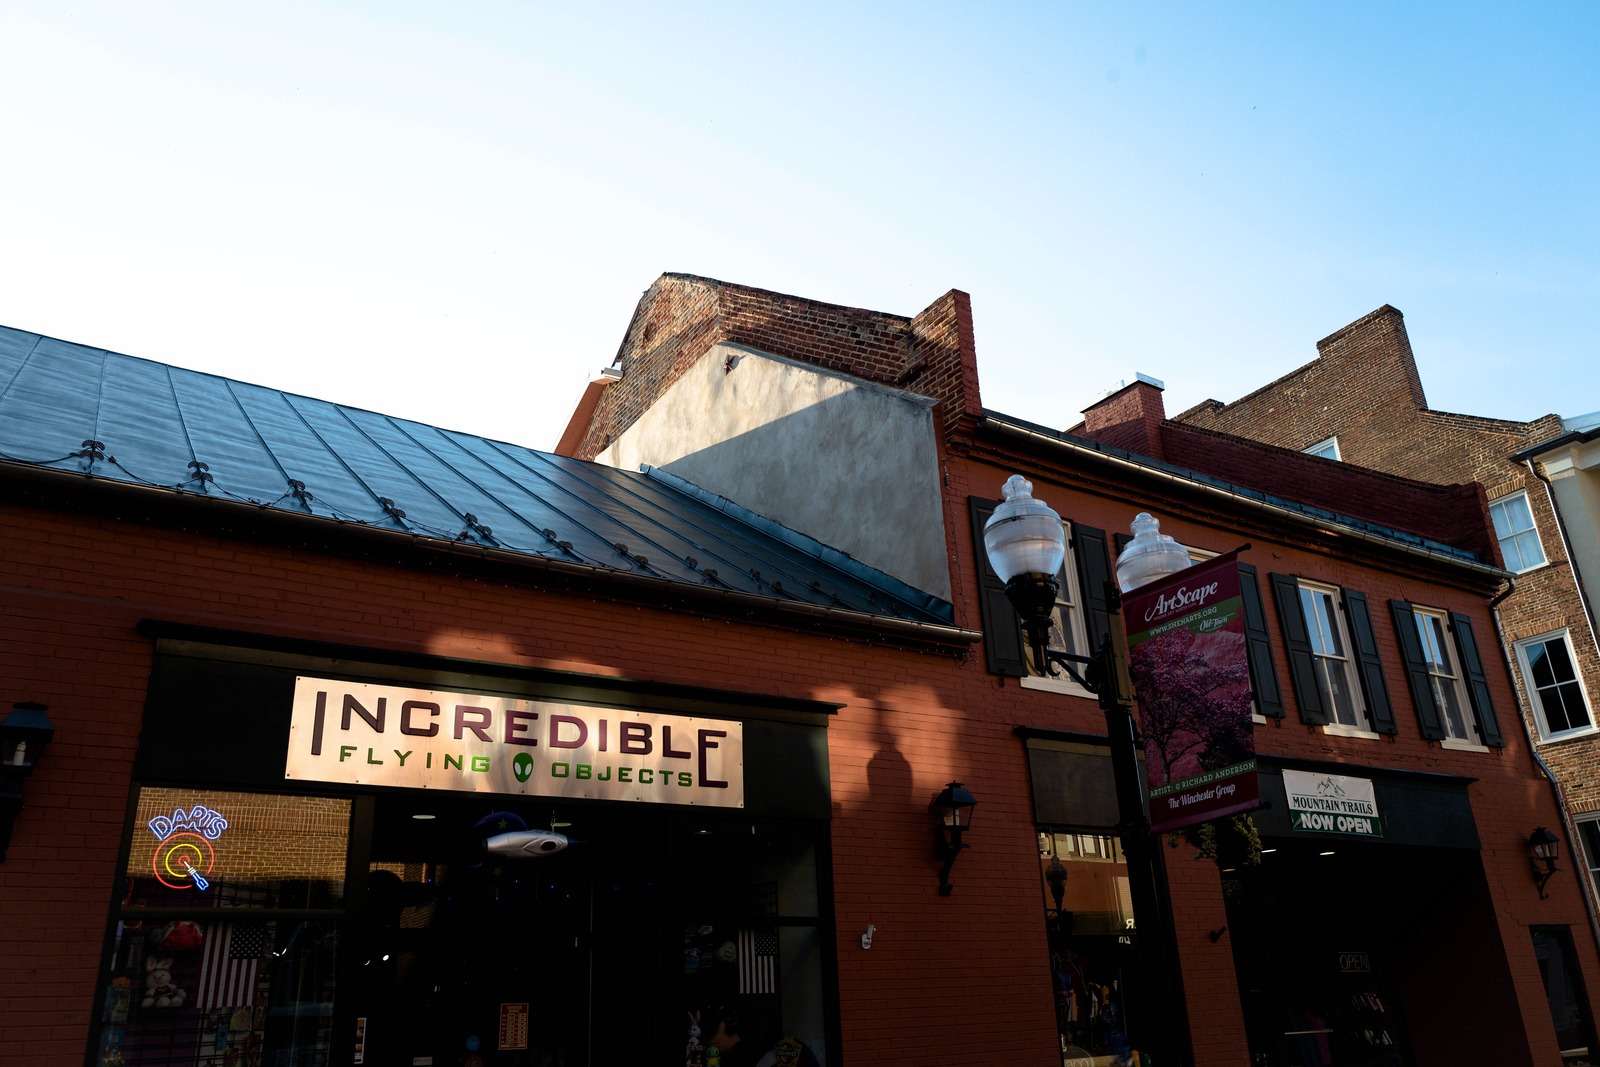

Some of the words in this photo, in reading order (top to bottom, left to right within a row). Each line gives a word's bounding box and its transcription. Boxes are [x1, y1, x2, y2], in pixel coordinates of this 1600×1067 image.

[1145, 582, 1218, 622] ArtScape
[1149, 606, 1218, 637] WWW.SHENARTS.ORG
[311, 691, 728, 788] INCREDIBLE
[339, 746, 490, 773] FLYING
[551, 762, 693, 787] OBJECTS
[1150, 786, 1174, 797] ARTIST:
[1181, 773, 1214, 789] RICHARD
[1215, 762, 1255, 780] ANDERSON
[1168, 798, 1180, 809] The
[1179, 789, 1215, 807] Winchester
[1215, 784, 1236, 799] Group
[1292, 796, 1340, 811] MOUNTAIN
[1340, 800, 1373, 815] TRAILS
[148, 805, 228, 841] DARTS
[1300, 813, 1334, 831] NOW
[1337, 816, 1373, 834] OPEN
[1340, 954, 1369, 970] OPEN
